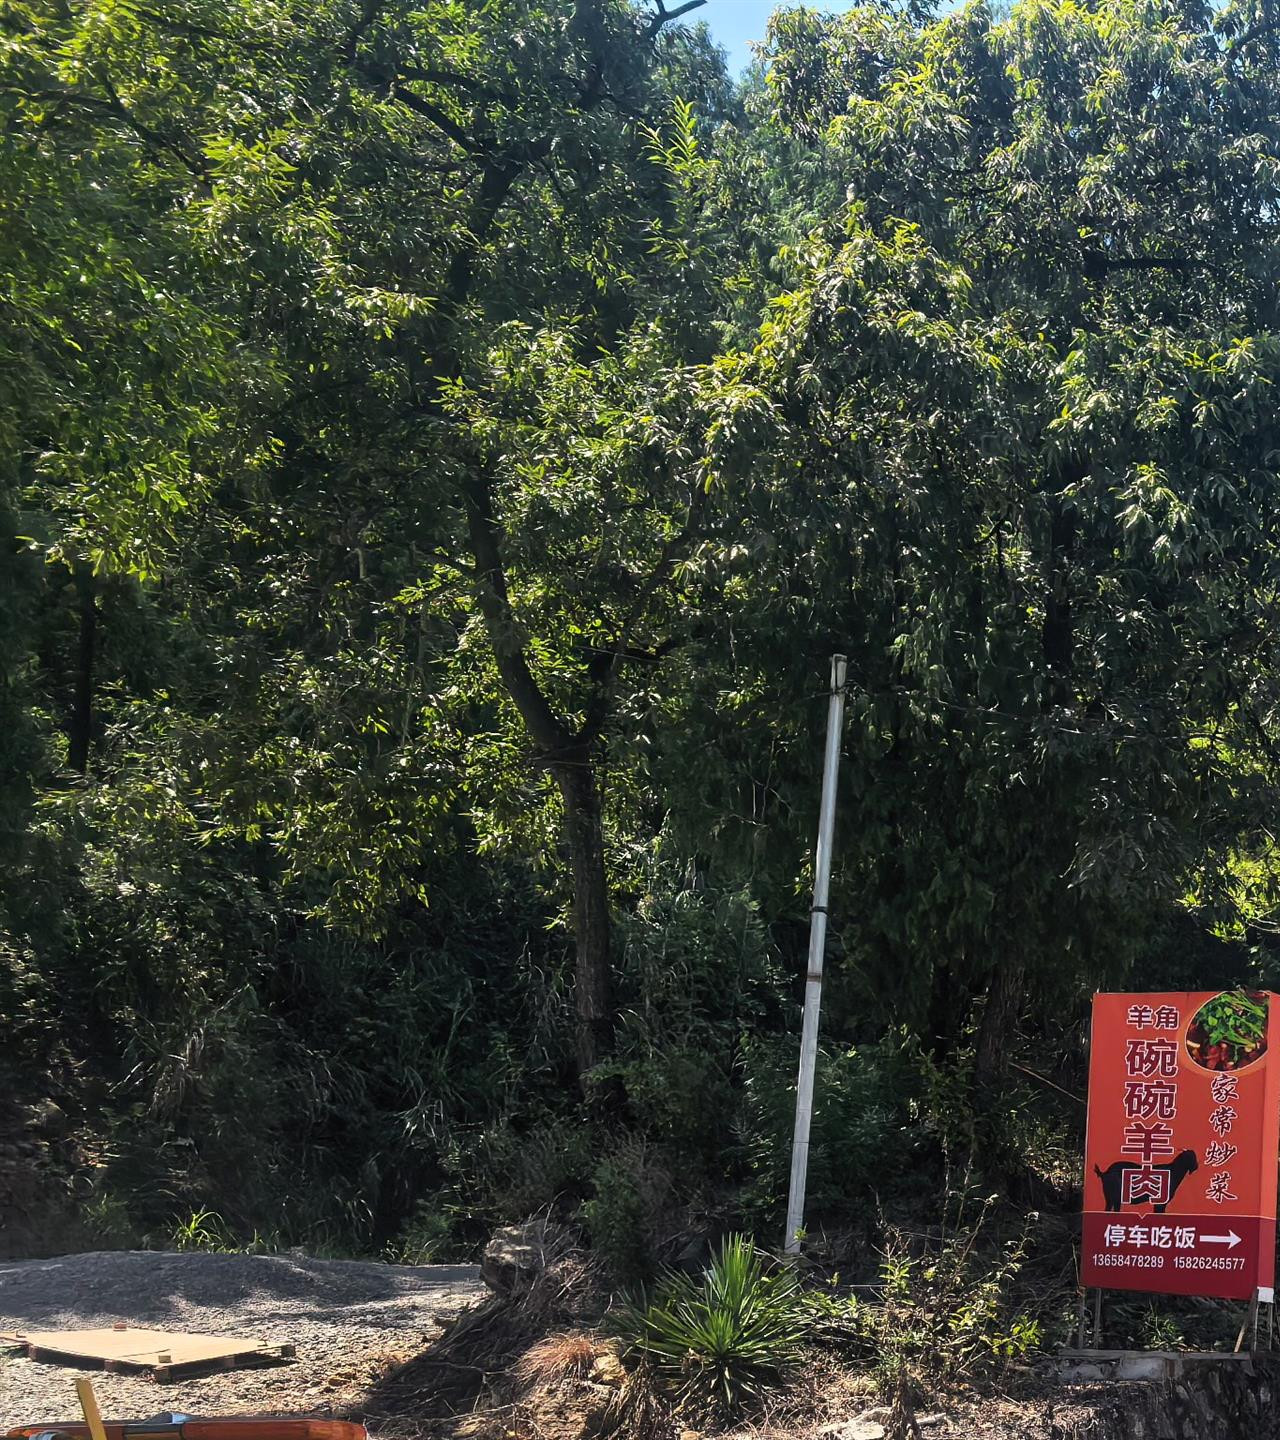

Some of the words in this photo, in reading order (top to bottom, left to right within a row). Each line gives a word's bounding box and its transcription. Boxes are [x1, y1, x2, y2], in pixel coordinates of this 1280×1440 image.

[1126, 1004, 1180, 1031] 羊角
[1120, 1037, 1179, 1206] 碗碗羊肉
[1203, 1073, 1239, 1204] 家常炒菜
[1103, 1224, 1196, 1251] 停车吃饭
[1092, 1254, 1164, 1268] 13658478289
[1172, 1256, 1245, 1270] 15826245577
